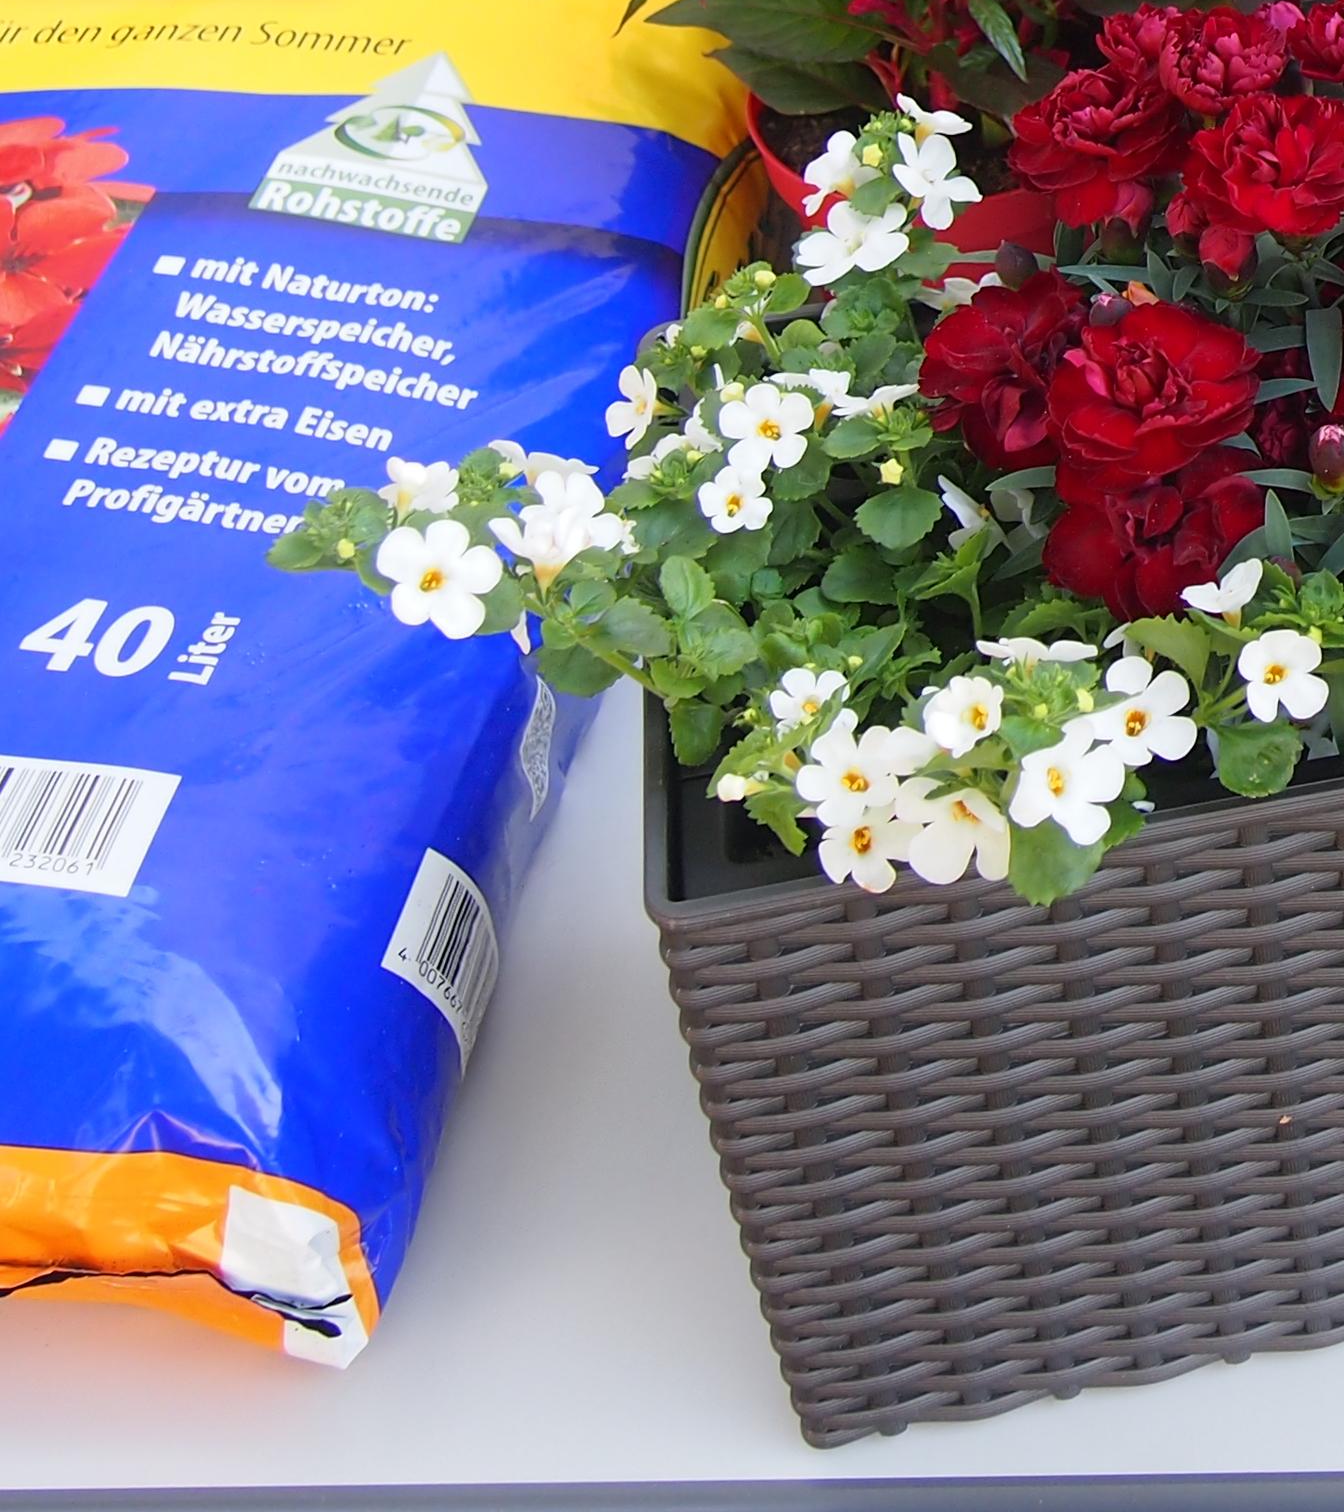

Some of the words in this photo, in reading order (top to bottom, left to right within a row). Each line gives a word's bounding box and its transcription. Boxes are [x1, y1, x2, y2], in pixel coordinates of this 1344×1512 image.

[33, 19, 102, 45] den
[106, 22, 243, 50] ganzen
[250, 20, 413, 57] Sommer
[257, 180, 462, 242] Rohstoffe
[277, 161, 474, 207] nachwachsende
[191, 257, 259, 286] mit
[261, 263, 439, 313] Naturton:
[175, 291, 456, 365] Wasserspeicher,
[149, 331, 479, 410] Nährstoffspeicher
[115, 388, 187, 418] mit
[189, 399, 290, 430] extra
[294, 406, 394, 451] Eisen
[84, 437, 261, 485] Rezeptur
[265, 466, 346, 498] vom
[62, 479, 305, 535] Profigärtner
[19, 598, 176, 678] 40
[168, 611, 242, 686] Liter
[9, 853, 94, 876] 232061
